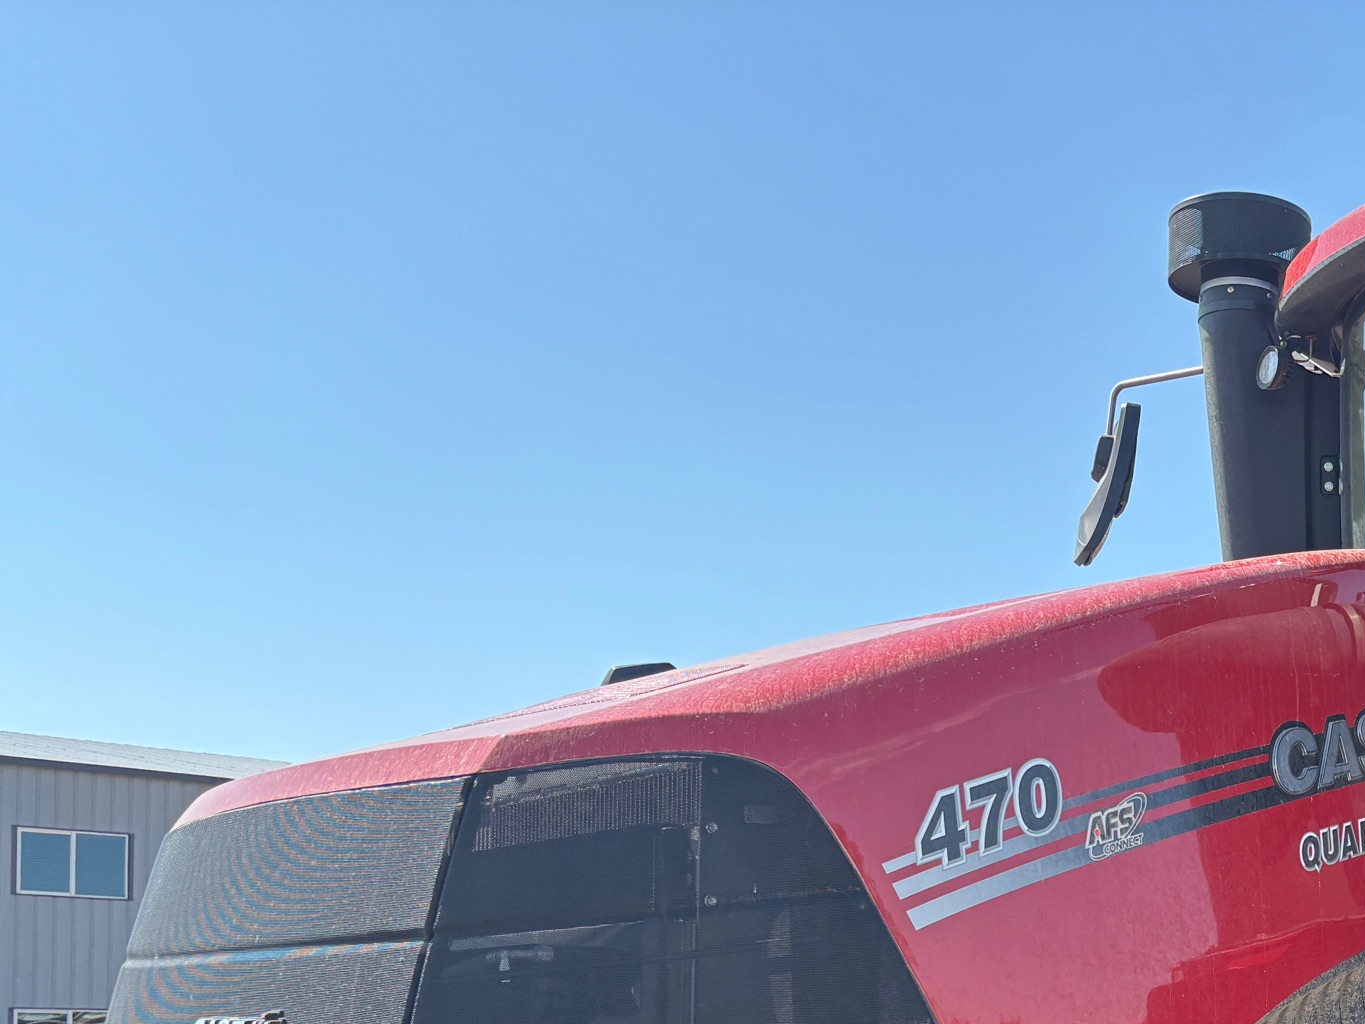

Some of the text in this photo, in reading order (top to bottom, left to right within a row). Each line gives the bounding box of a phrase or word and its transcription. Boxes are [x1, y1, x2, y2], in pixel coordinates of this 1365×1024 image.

[916, 757, 1063, 869] 470
[1085, 802, 1136, 849] AFS
[1103, 833, 1144, 856] CONNECT
